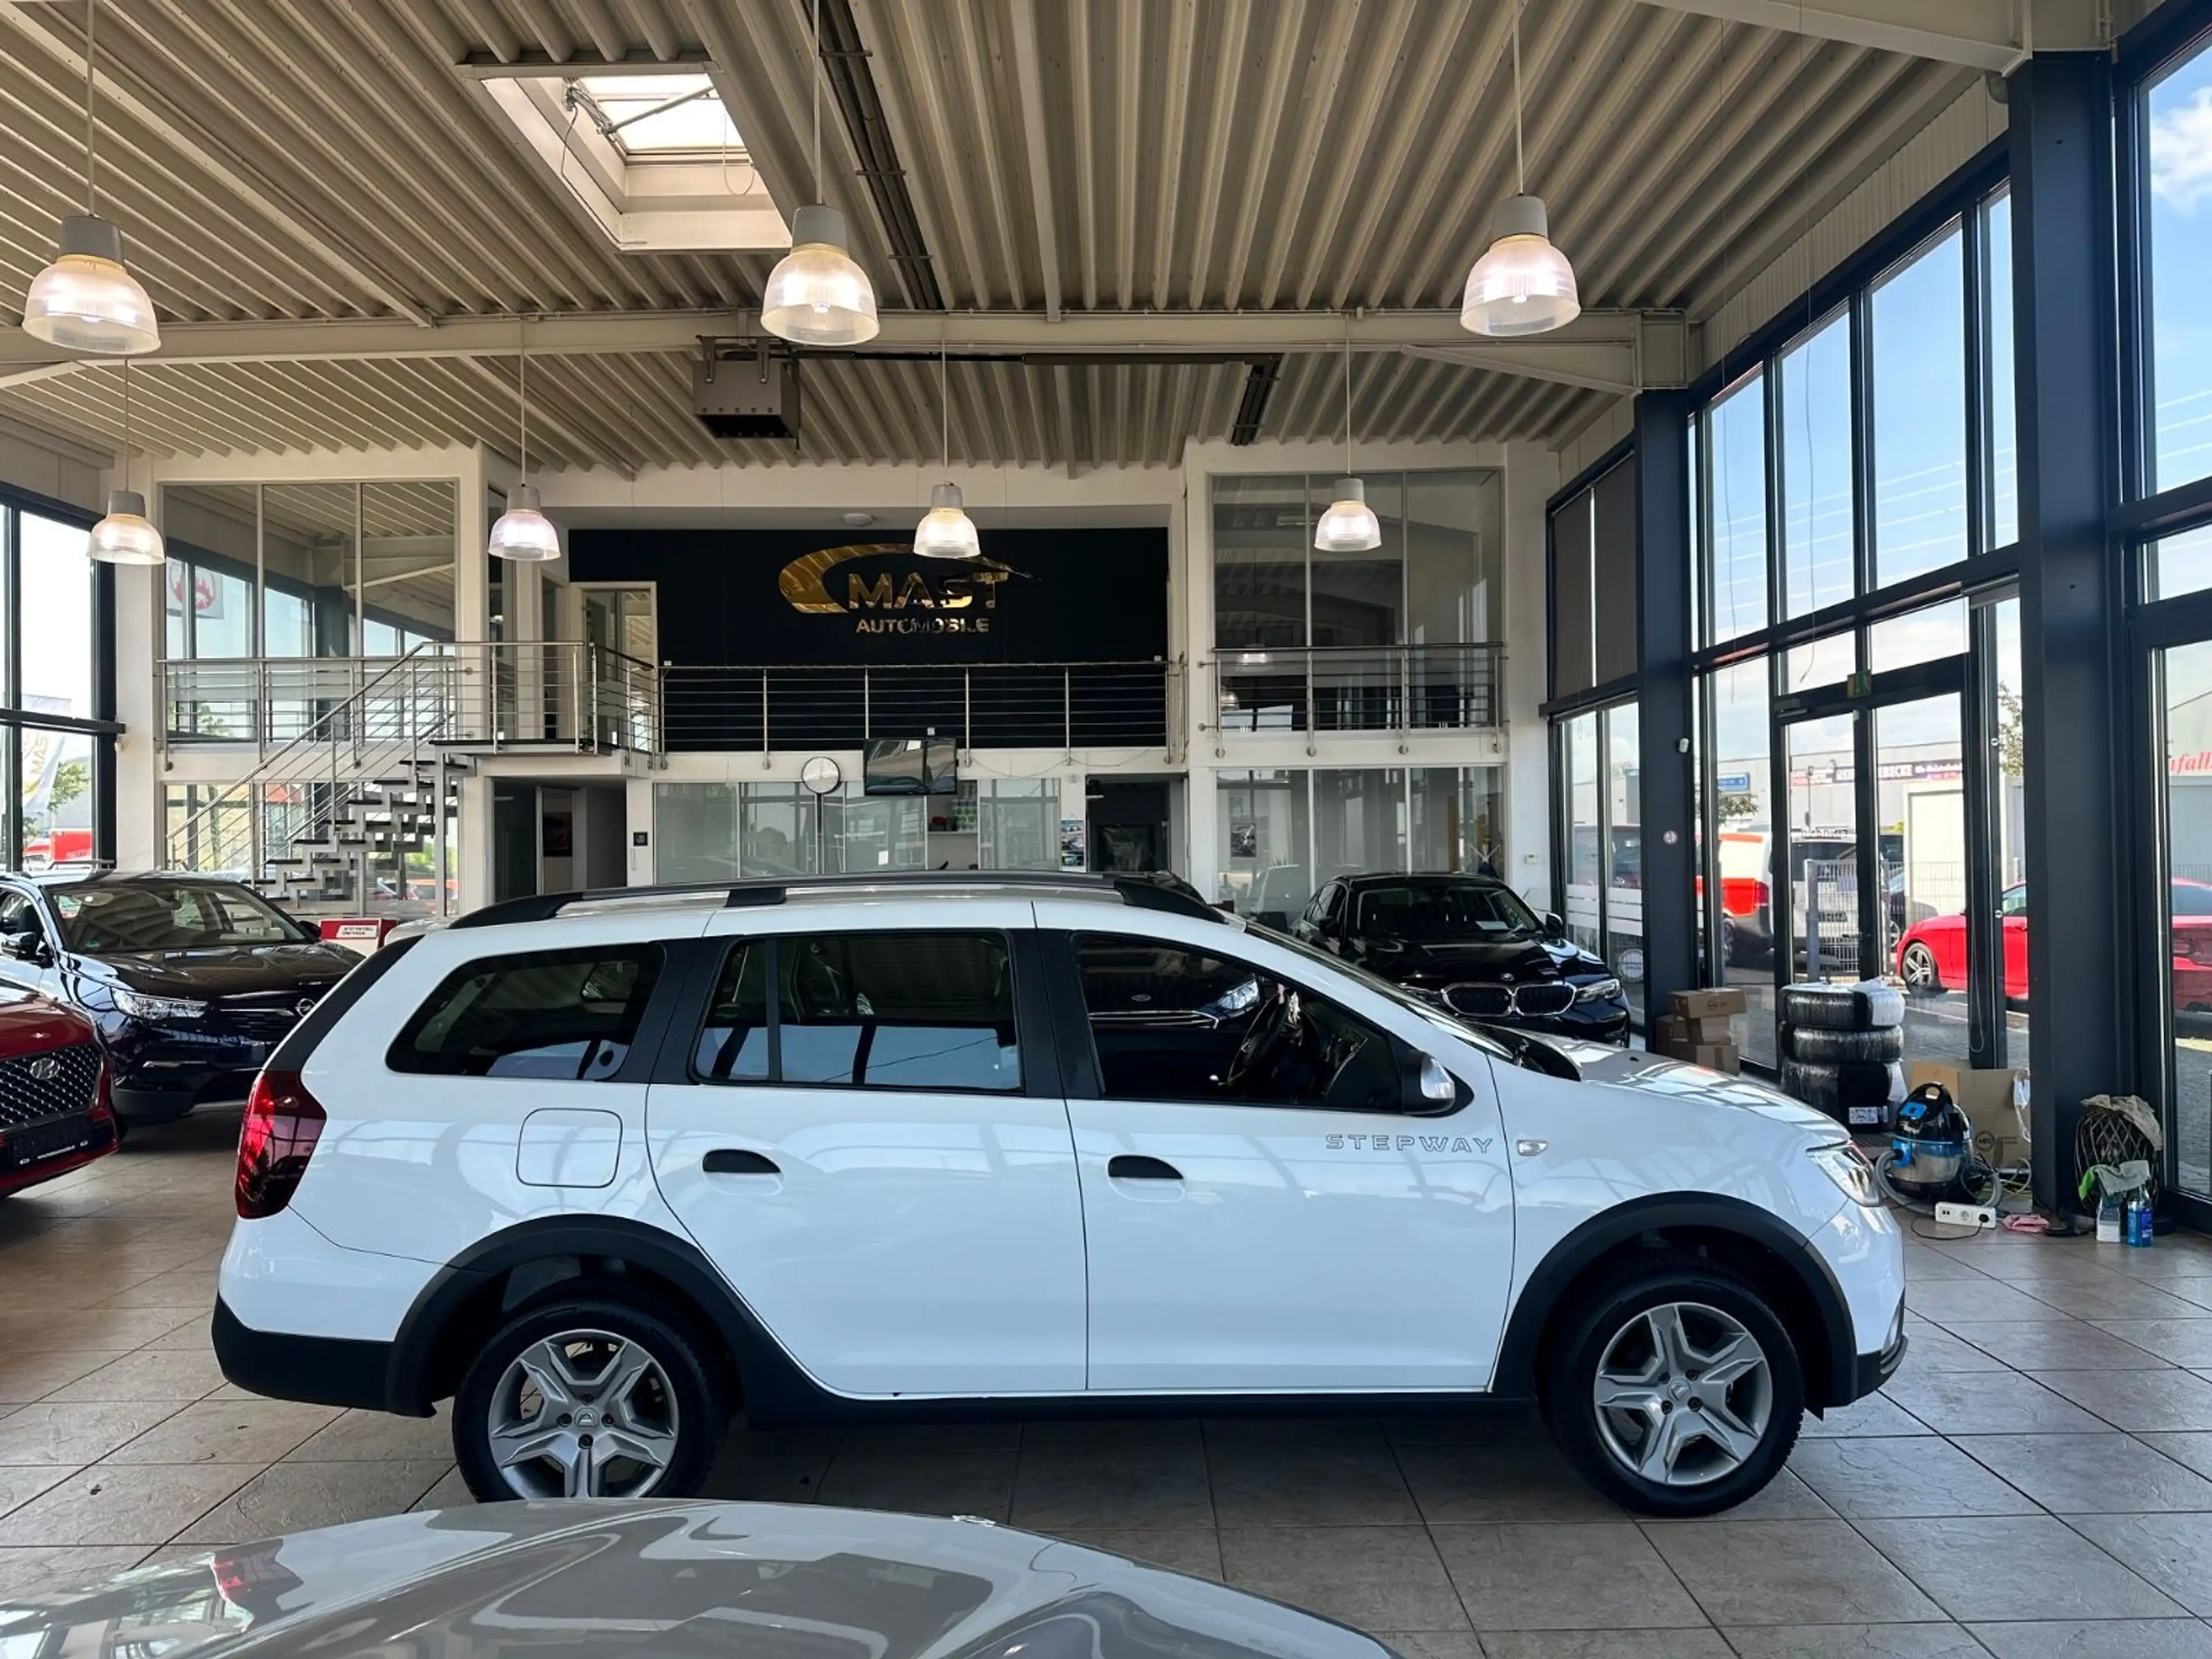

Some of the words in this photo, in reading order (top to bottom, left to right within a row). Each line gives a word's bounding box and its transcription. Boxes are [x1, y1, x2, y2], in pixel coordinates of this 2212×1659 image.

[849, 572, 1009, 609] MAST
[856, 618, 990, 634] AUTOMOBILE
[1326, 1134, 1493, 1153] STEPWAY
